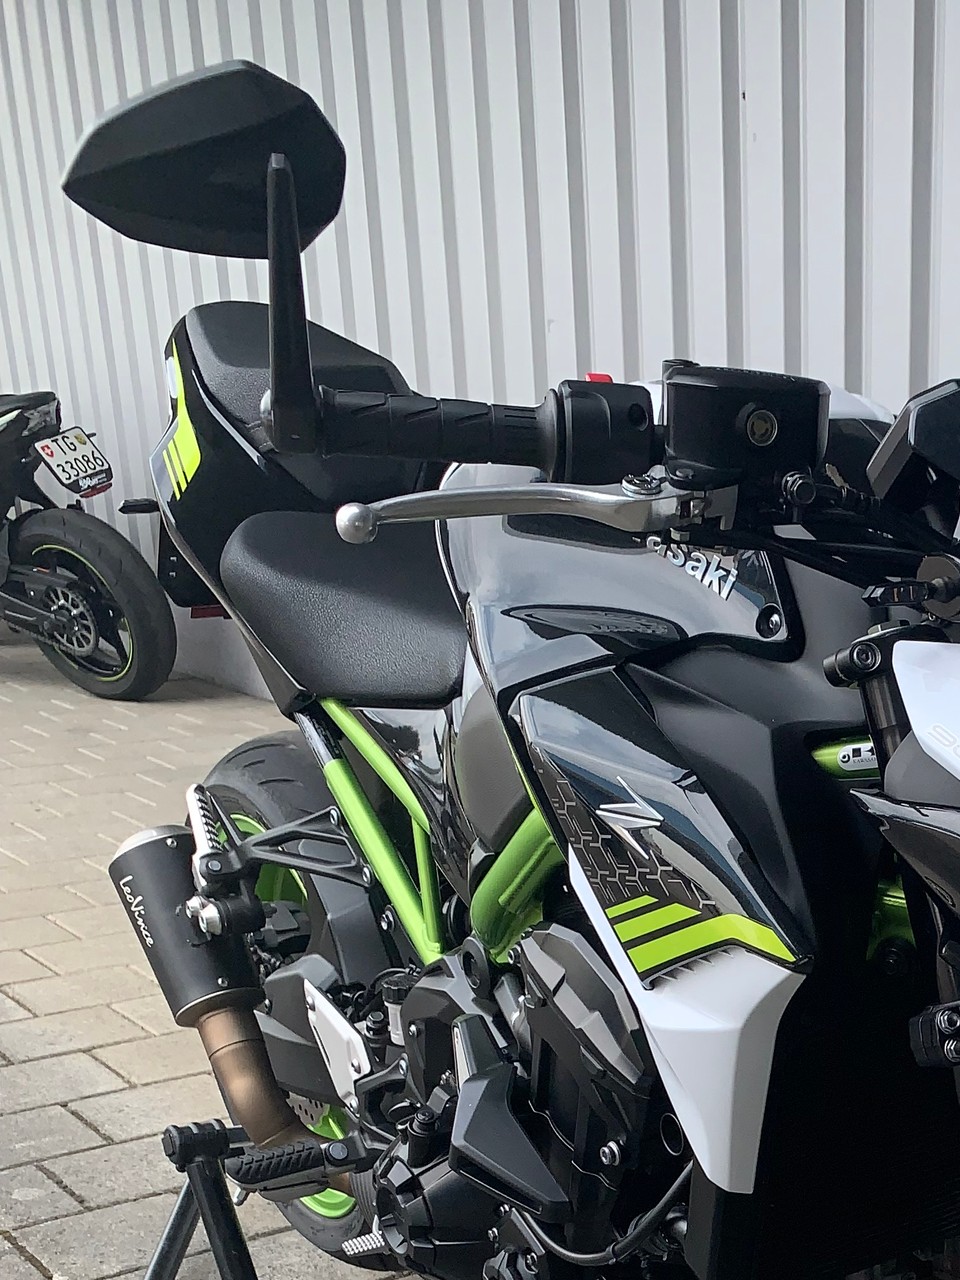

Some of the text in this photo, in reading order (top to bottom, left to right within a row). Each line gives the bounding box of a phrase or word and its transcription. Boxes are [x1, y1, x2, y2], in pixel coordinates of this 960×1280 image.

[51, 435, 77, 456] TG
[56, 450, 105, 481] 33086
[646, 535, 739, 601] asaki
[119, 874, 155, 949] LeoVince
